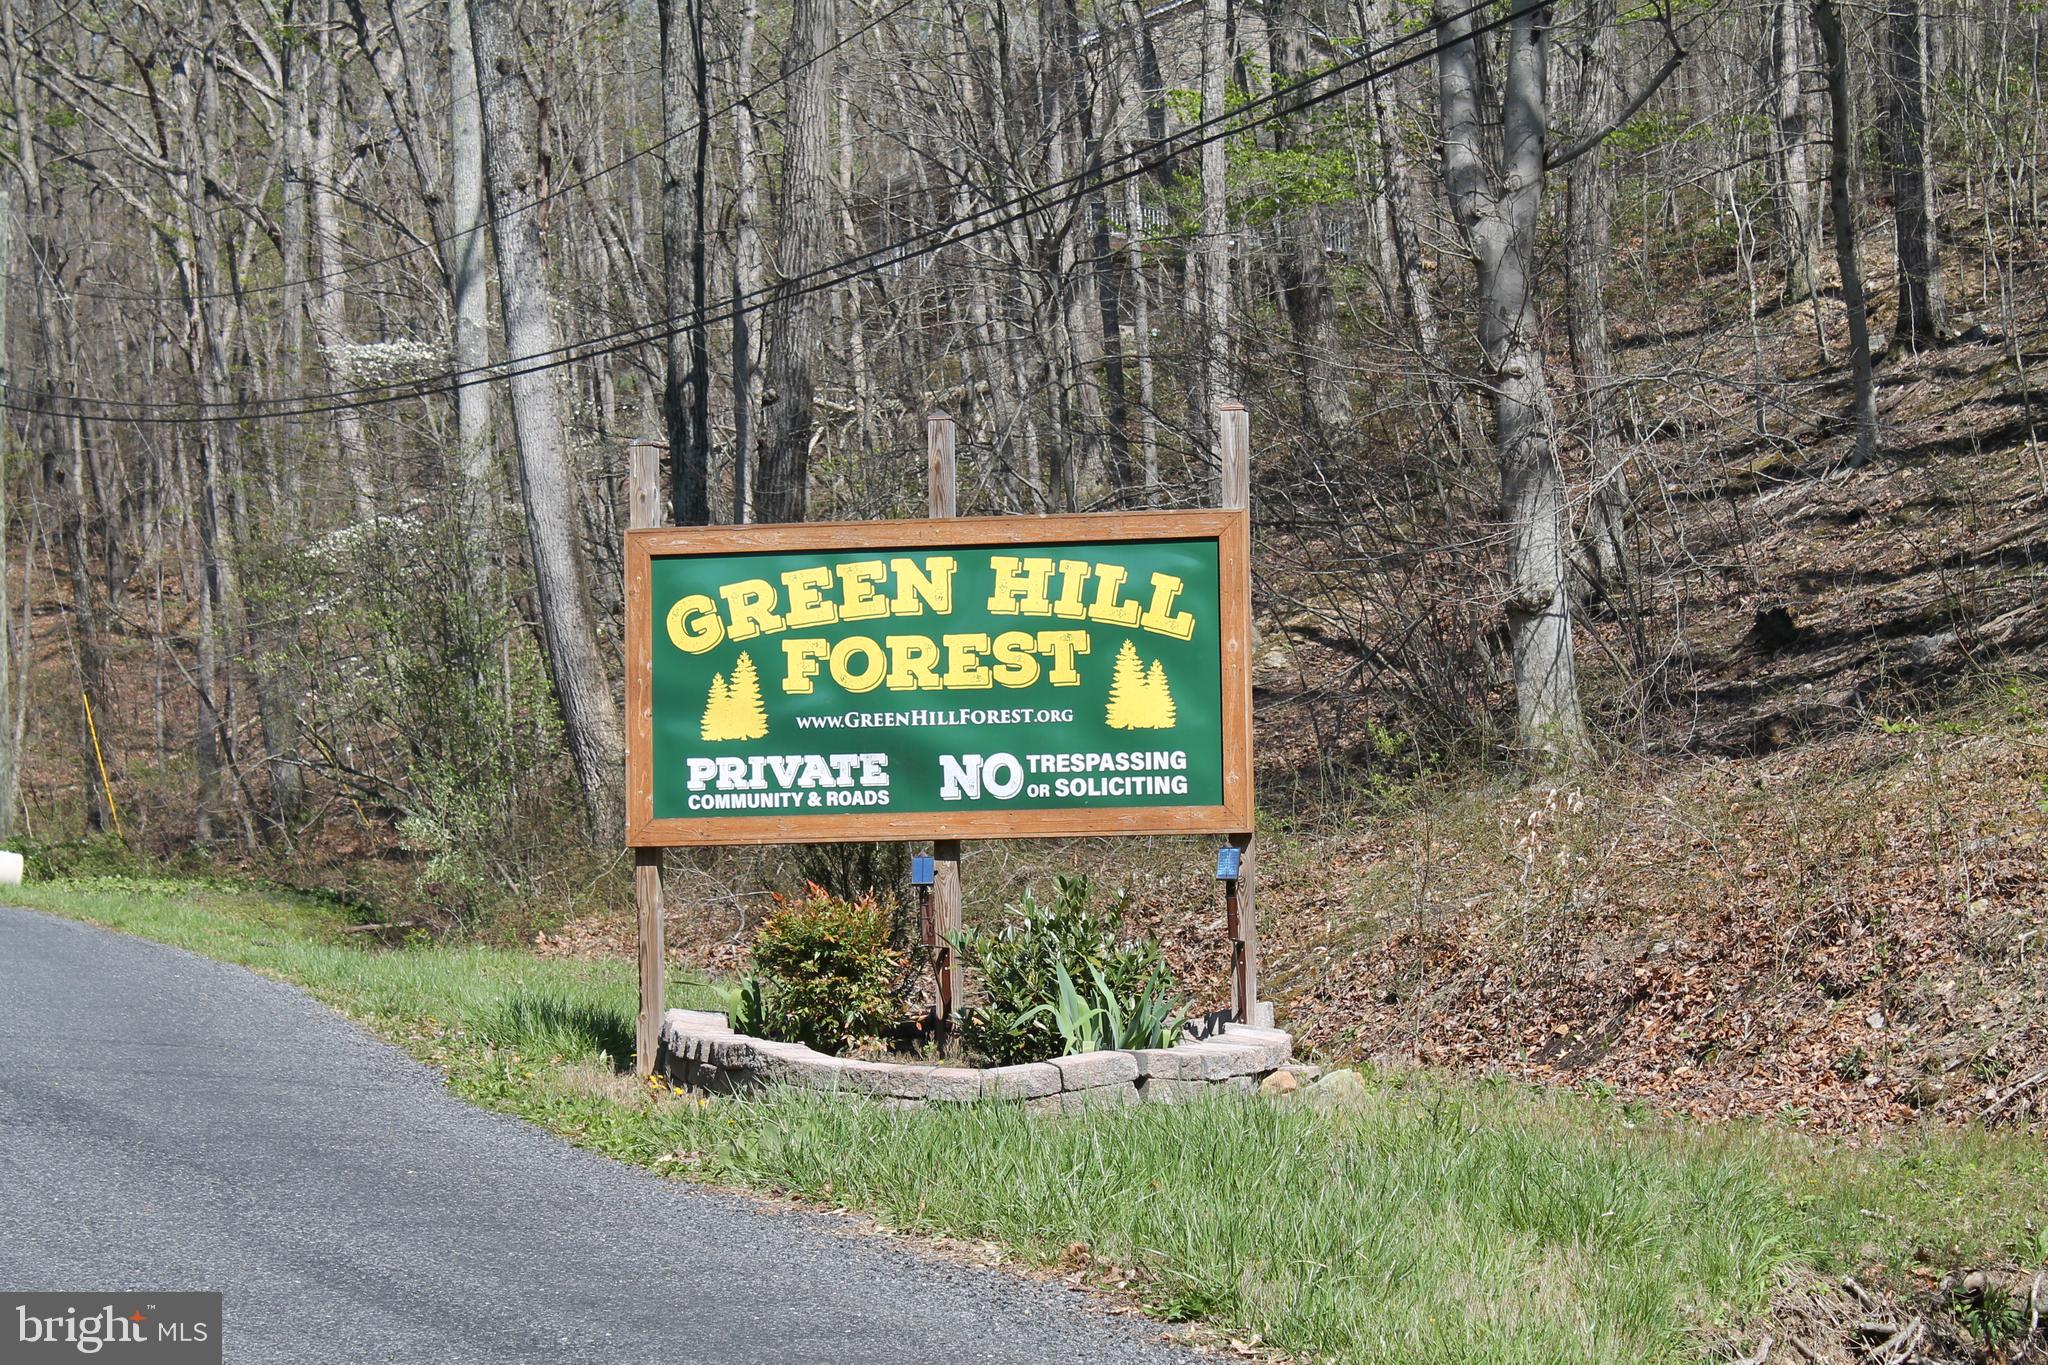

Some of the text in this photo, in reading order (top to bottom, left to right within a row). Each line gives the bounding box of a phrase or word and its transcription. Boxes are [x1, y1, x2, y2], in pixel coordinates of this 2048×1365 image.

[666, 556, 1195, 655] GREEN HILL
[782, 630, 1091, 695] FOREST
[686, 752, 890, 791] PRIVATE
[939, 752, 1025, 801] NO
[1026, 750, 1187, 774] TRESPASSING
[687, 789, 890, 811] COMMUNITY & ROADS
[1026, 774, 1189, 798] OR SOLICITING
